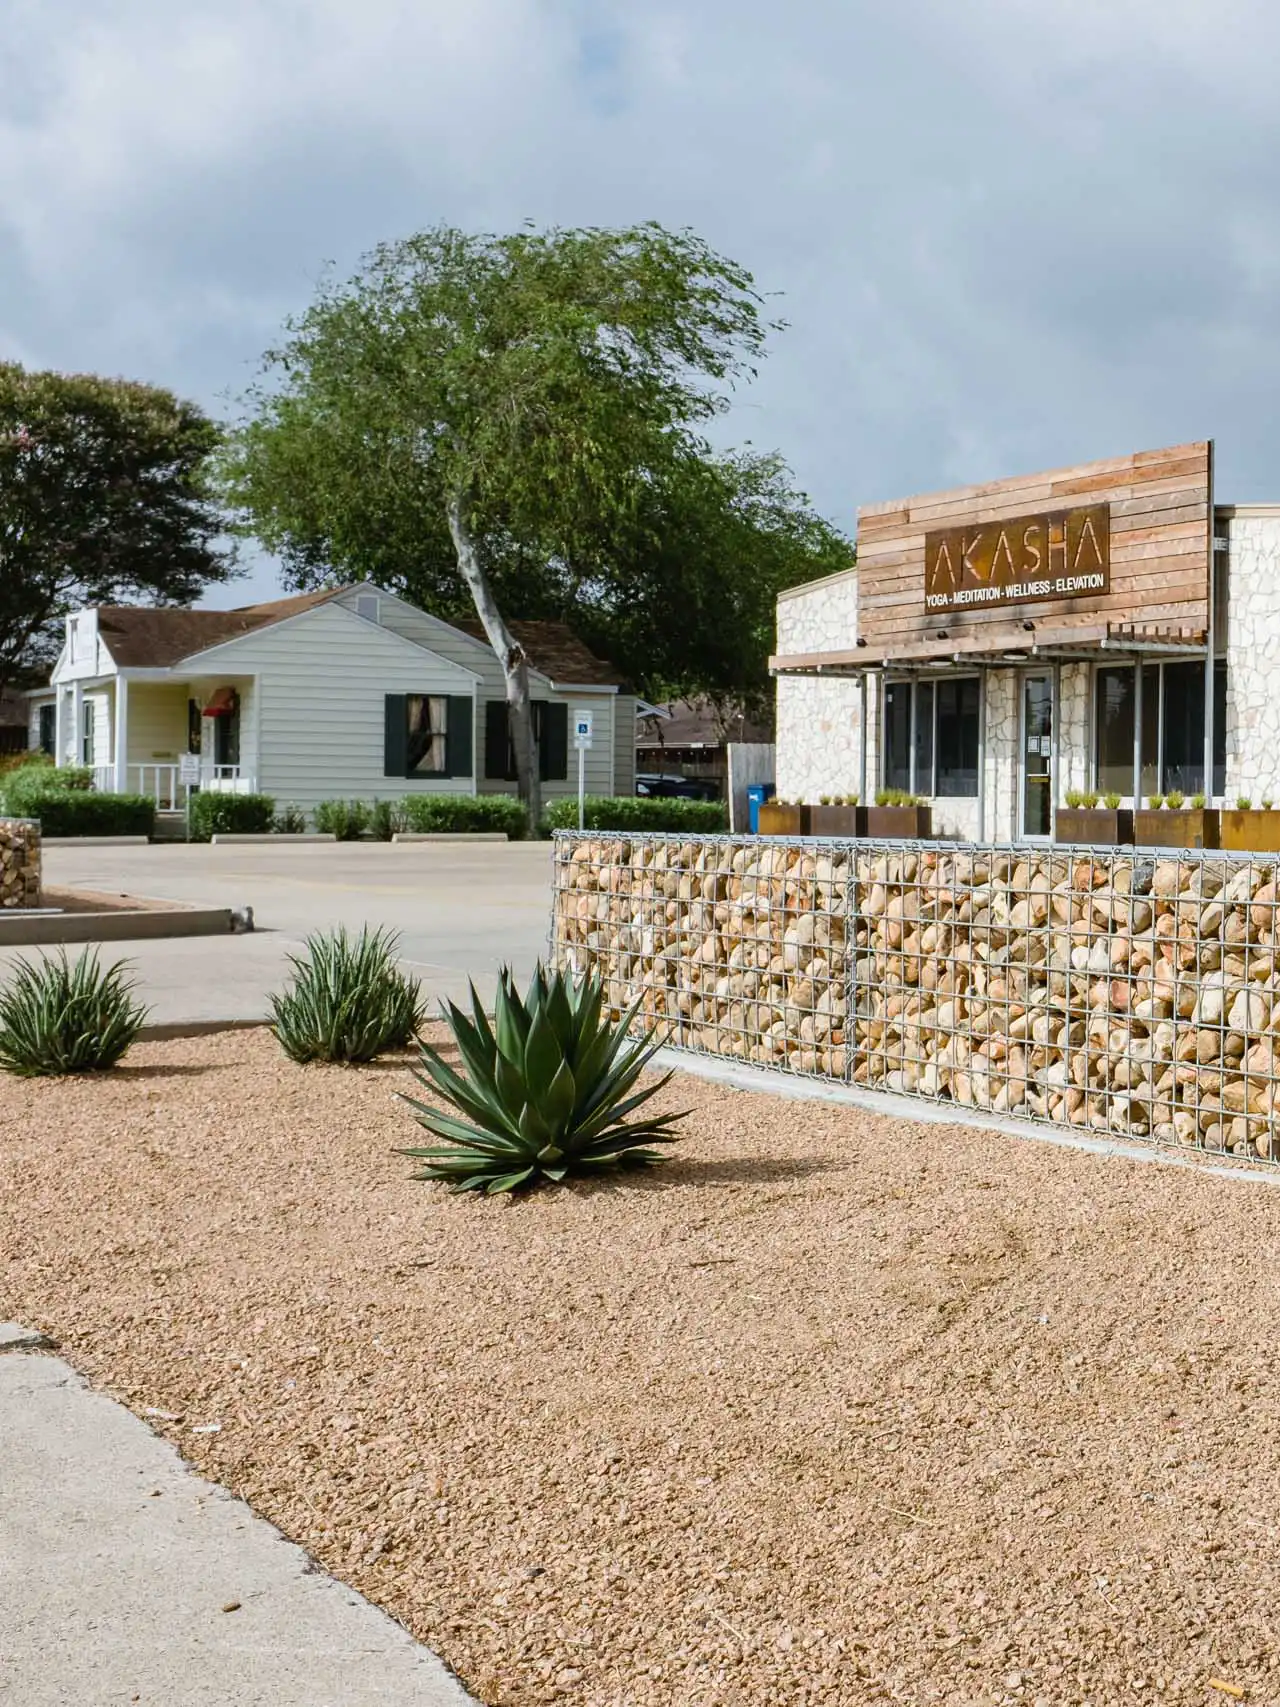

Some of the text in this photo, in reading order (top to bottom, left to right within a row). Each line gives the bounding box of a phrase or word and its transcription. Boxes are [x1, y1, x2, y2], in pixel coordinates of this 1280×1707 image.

[931, 516, 1103, 588] AKASHA
[926, 593, 949, 608] YOGA
[953, 586, 1001, 604] MEDITATION
[1005, 580, 1050, 598] WELLNESS
[1056, 573, 1104, 592] ELEVATION
